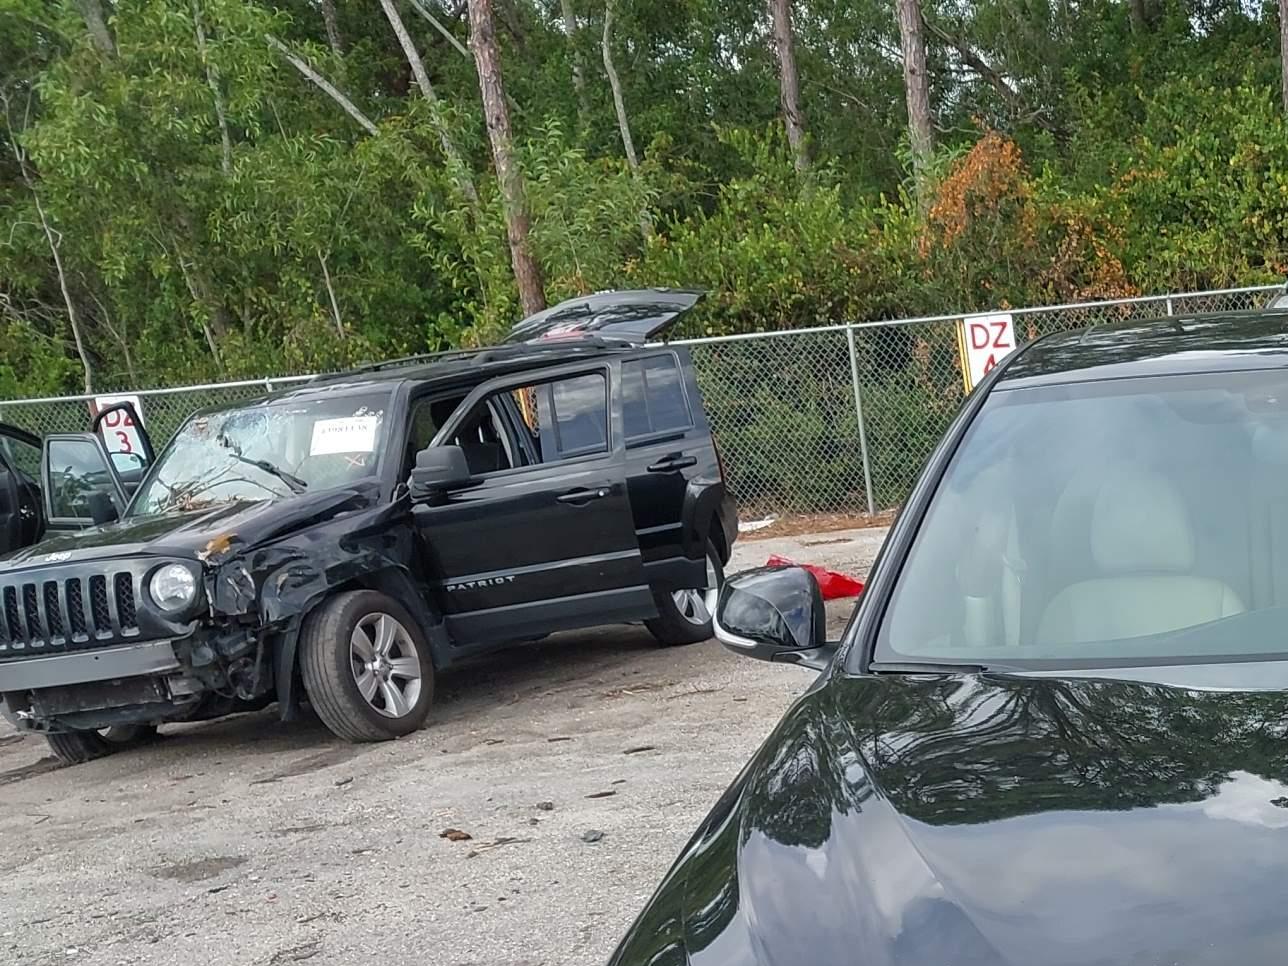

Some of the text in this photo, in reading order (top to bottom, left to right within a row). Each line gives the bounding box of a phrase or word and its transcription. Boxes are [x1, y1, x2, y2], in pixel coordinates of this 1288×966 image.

[969, 322, 1011, 350] DZ
[115, 431, 132, 452] 3
[446, 575, 515, 592] PATRIOT
